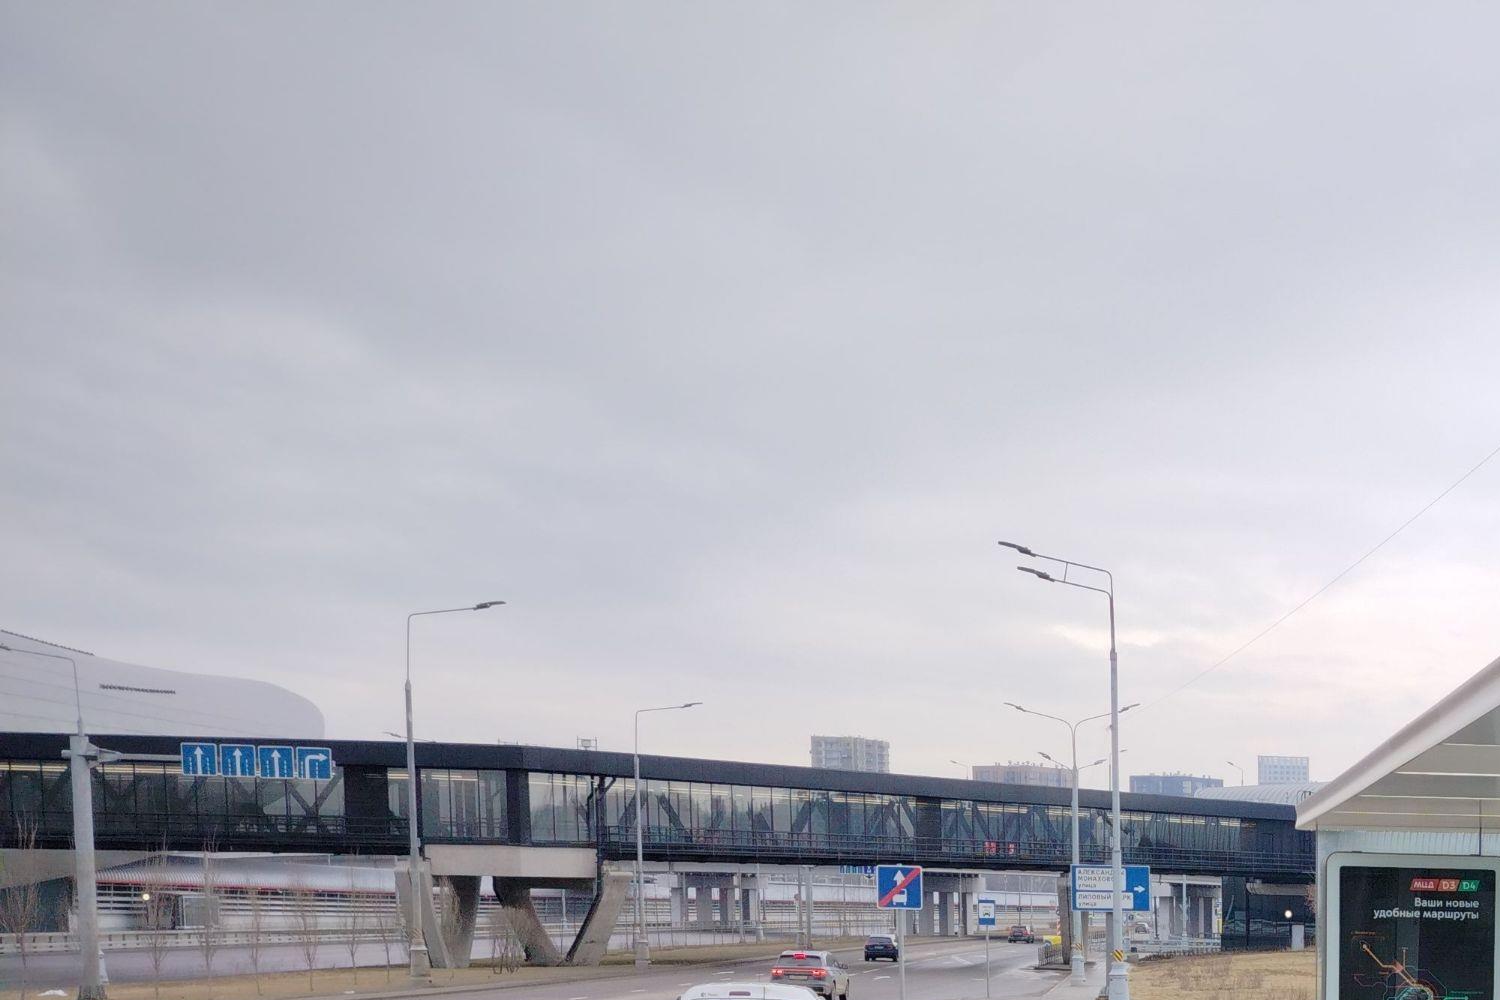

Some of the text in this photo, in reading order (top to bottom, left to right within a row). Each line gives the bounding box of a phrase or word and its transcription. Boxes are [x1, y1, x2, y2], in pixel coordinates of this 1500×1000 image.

[1442, 881, 1476, 890] D3 D4
[1414, 897, 1480, 908] Ваши новые
[1373, 907, 1479, 920] удобные маршруты
